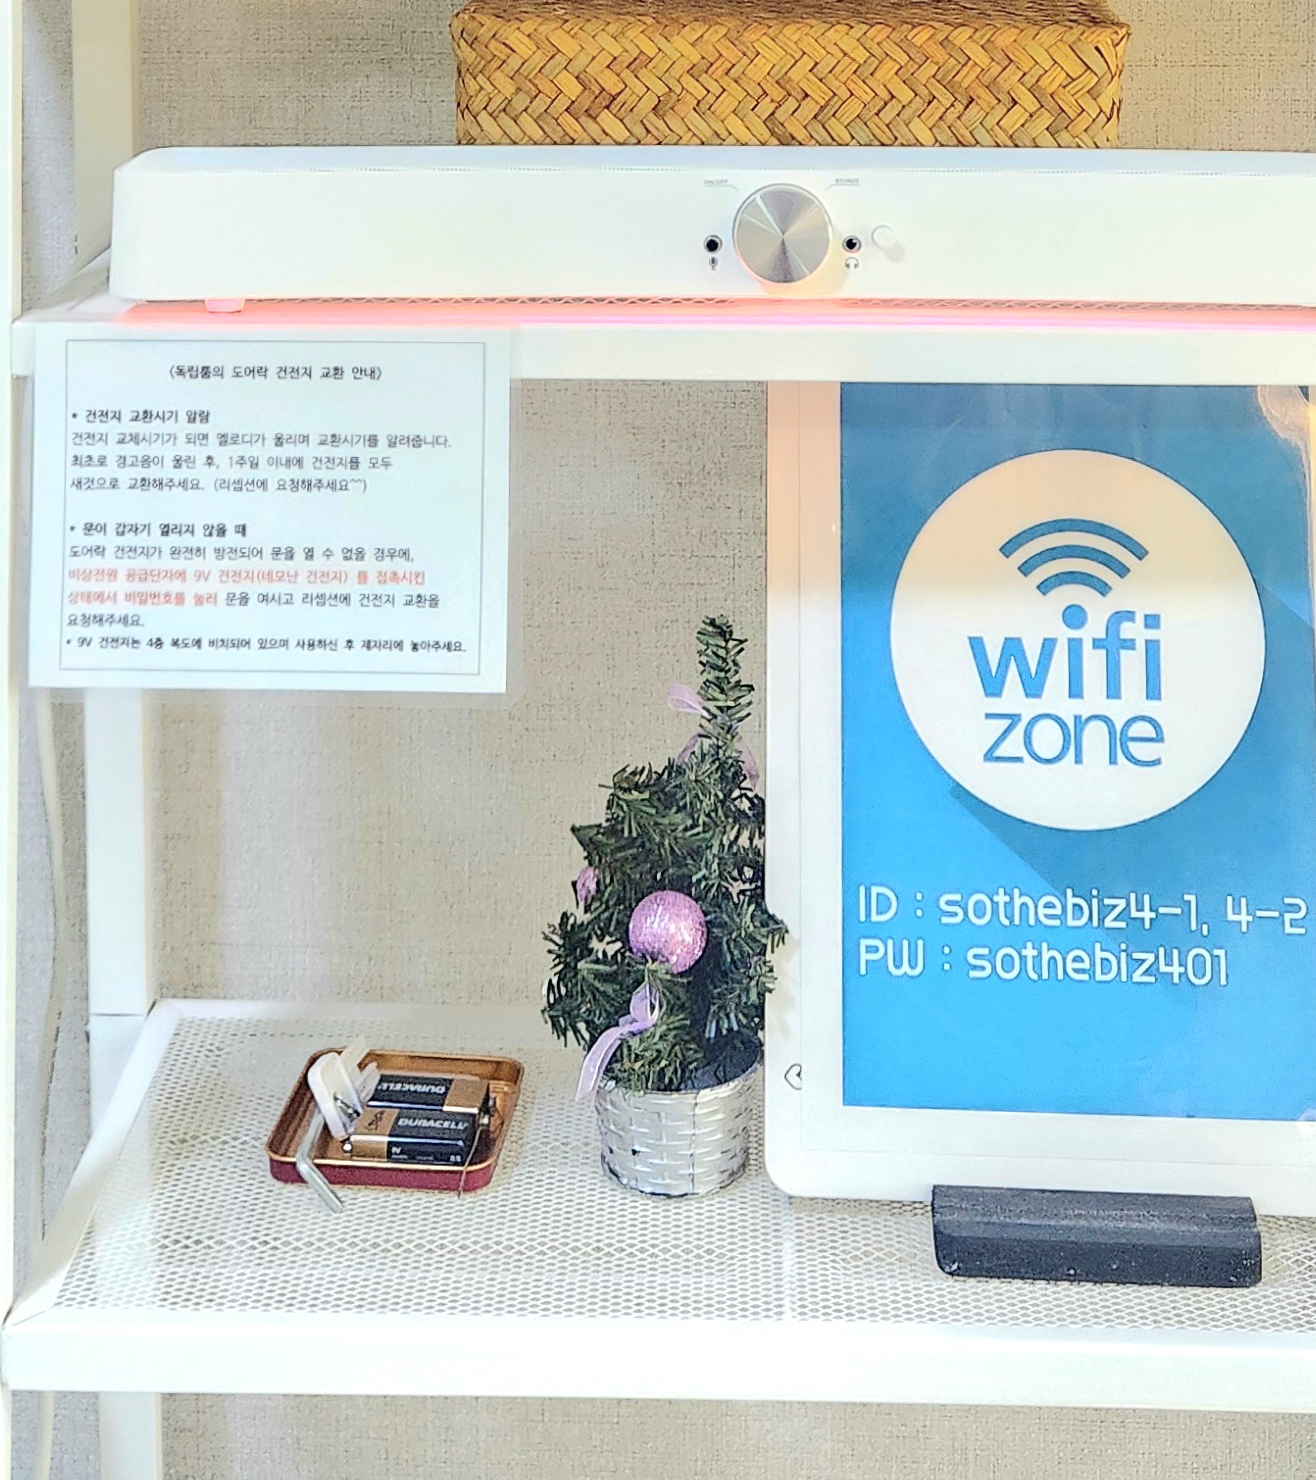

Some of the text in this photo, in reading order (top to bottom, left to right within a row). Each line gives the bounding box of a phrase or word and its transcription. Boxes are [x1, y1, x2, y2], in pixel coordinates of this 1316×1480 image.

[231, 366, 268, 379] 도어락
[276, 366, 313, 380] 건전지
[320, 366, 344, 380] 교환
[85, 410, 211, 424] 건전지 교환시기 알람
[71, 432, 451, 448] 건전지 교체시기가 되면 멜로디가 울리며 교환시기를 알려줍니다.
[70, 455, 393, 470] 최초로 경고음이 울린 후, 1주일 이내에 건전지를 모두
[70, 478, 120, 490] 새것으로
[127, 478, 205, 491] 교환해주세요.
[214, 479, 268, 492] (리셉션에
[83, 522, 247, 537] 문이 갑자기 열리지 않을 때
[69, 546, 106, 559] 도어락
[114, 546, 162, 560] 건전지가
[170, 547, 206, 560] 완전히
[214, 547, 263, 560] 방전되어
[271, 547, 295, 560] 문을
[303, 547, 314, 561] 열
[322, 547, 334, 560] 수
[342, 547, 366, 561] 없을
[68, 569, 118, 582] 비상전원
[125, 569, 187, 582] 공급단자에
[194, 570, 211, 582] 9V
[219, 570, 299, 583] 건전지(네모난
[306, 571, 349, 584] 건전지)
[357, 571, 368, 585] 를
[67, 592, 118, 605] 상태에서
[125, 592, 185, 605] 비밀번호를
[225, 592, 250, 606] 문을
[257, 593, 294, 606] 여시고
[302, 593, 351, 607] 리셉션에
[359, 594, 395, 608] 건전지
[403, 594, 440, 608] 교환을
[67, 614, 144, 627] 요청해주세요.
[77, 637, 466, 652] 9V 건전지는 4층 복도에 비치되어 있으며 사용하신 후 제자리에 놓아주세요.
[968, 604, 1164, 703] wifi
[983, 712, 1164, 768] zone
[857, 884, 898, 923] ID
[939, 888, 1209, 937] sothebiz4-1,
[1225, 896, 1308, 935] 4-2
[857, 938, 925, 977] PW
[966, 941, 1228, 987] sothebiz401
[397, 1118, 466, 1129] DURACELL
